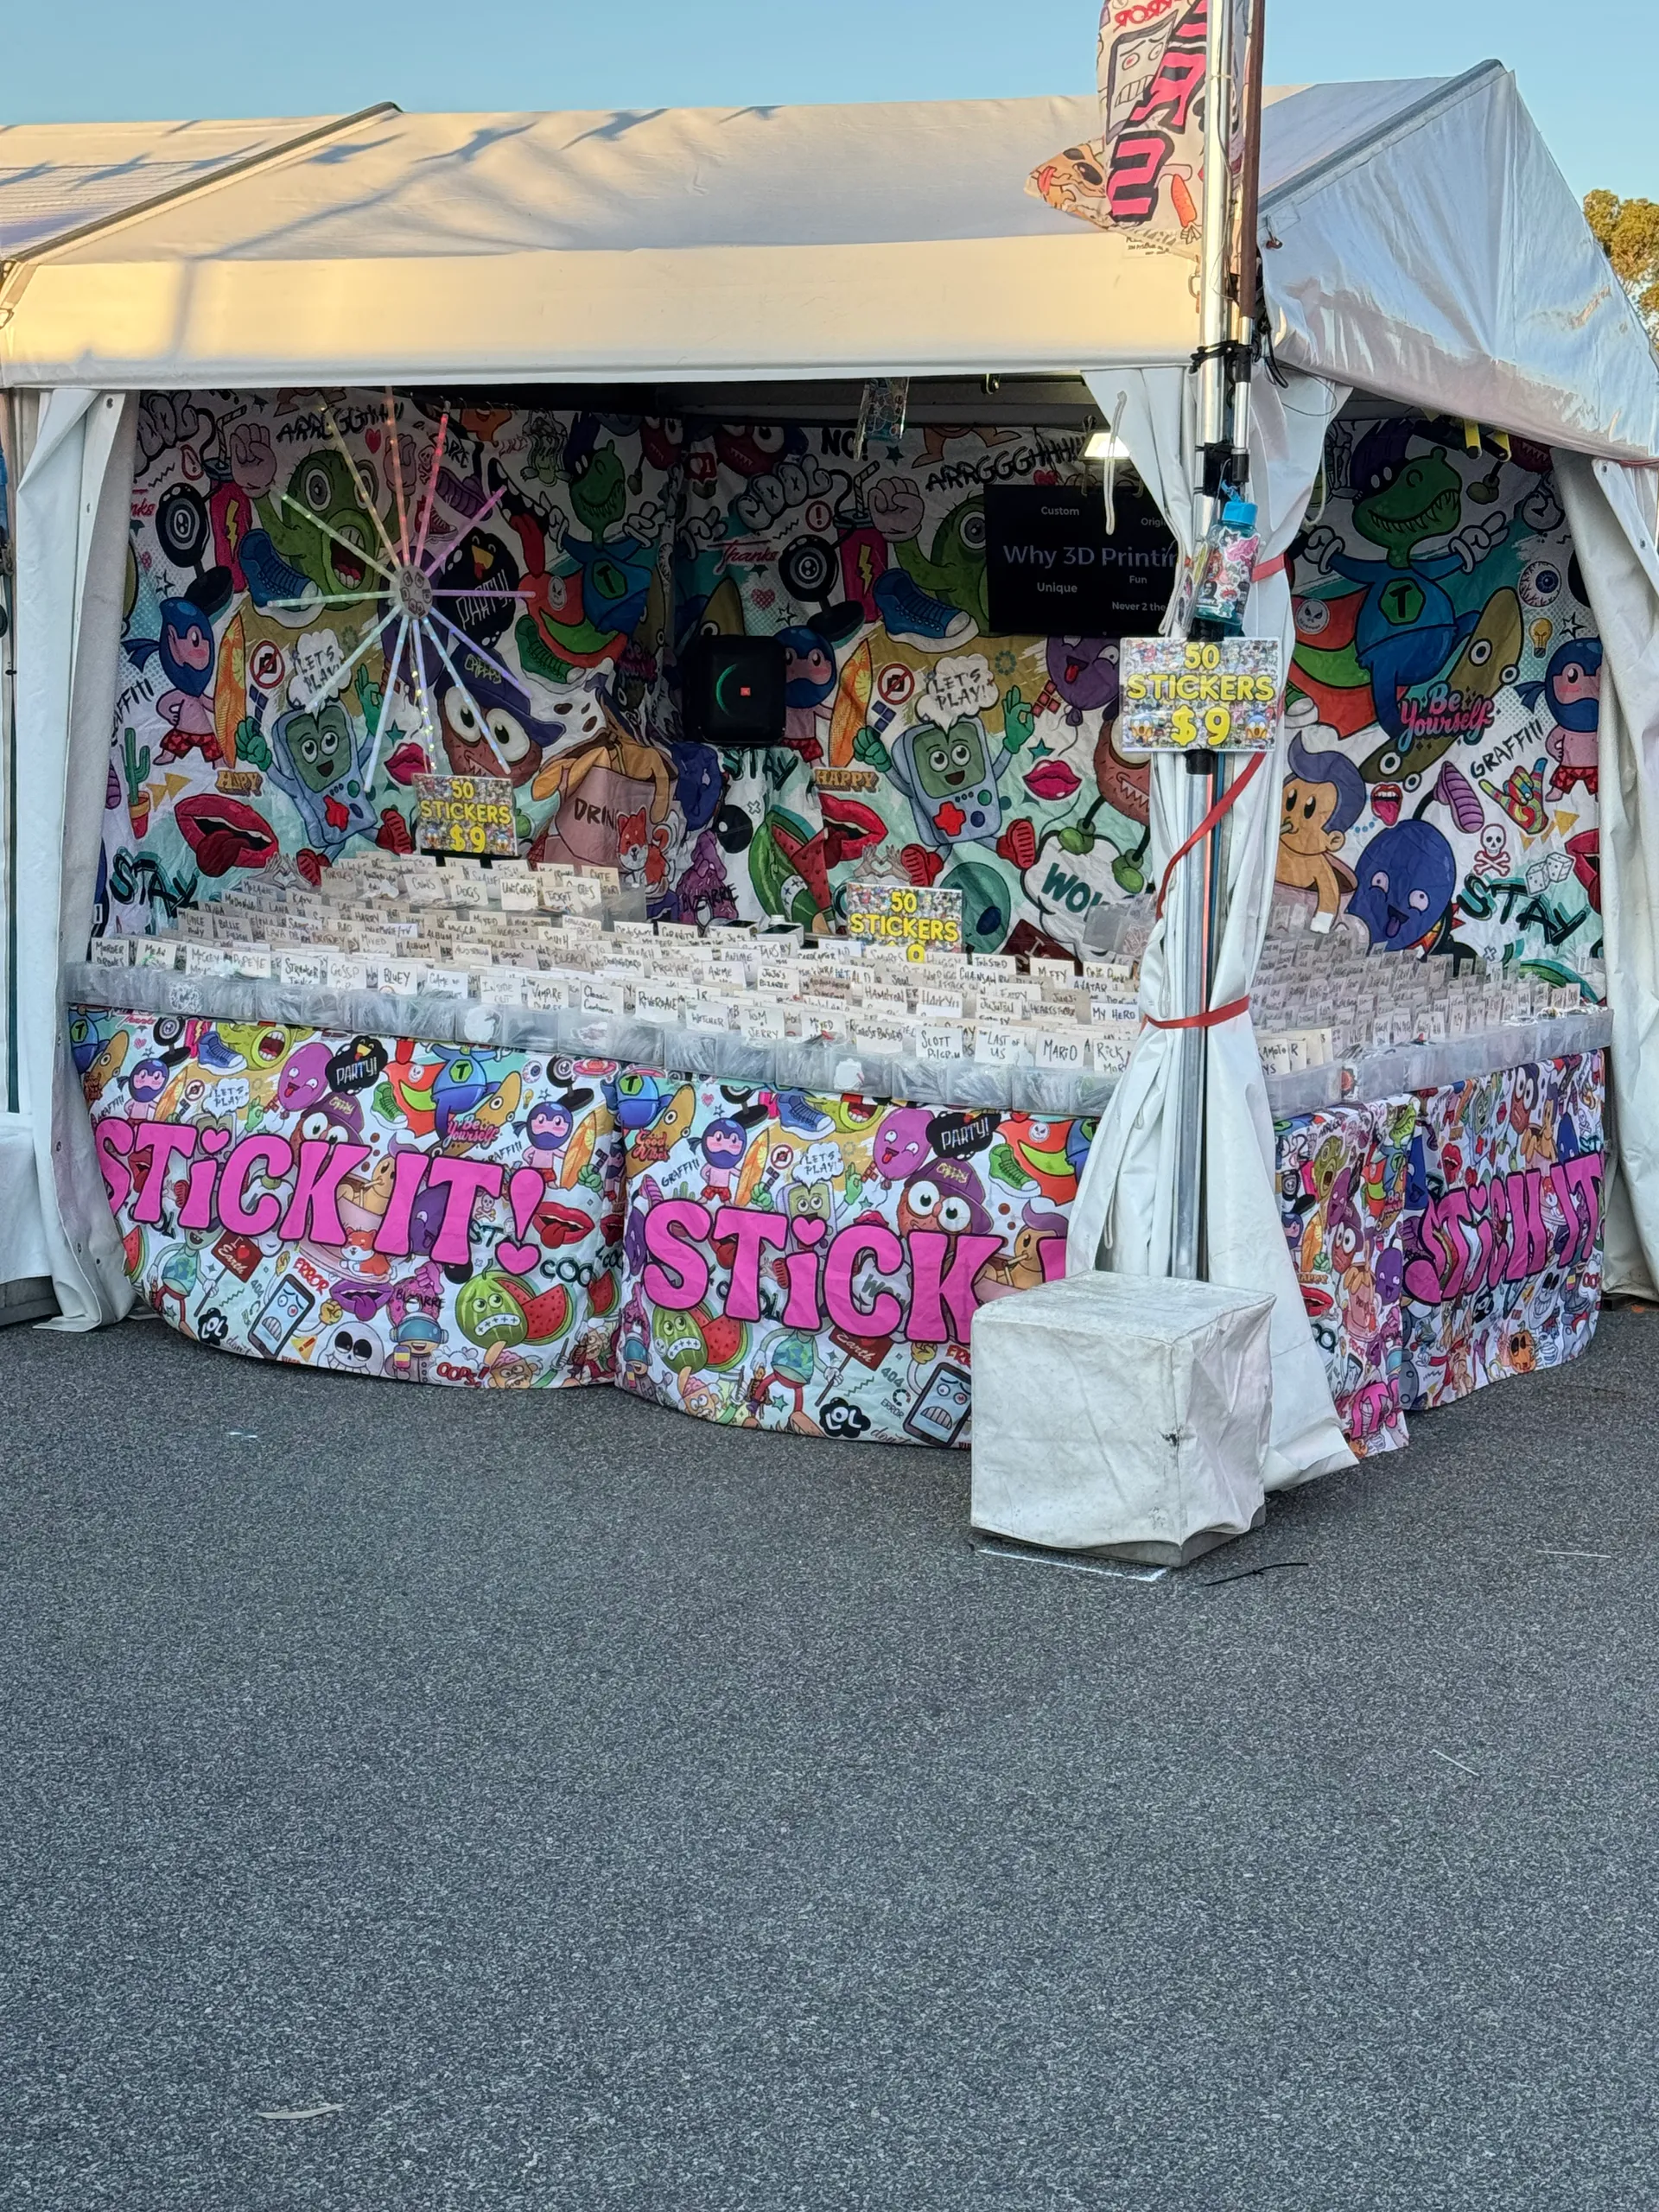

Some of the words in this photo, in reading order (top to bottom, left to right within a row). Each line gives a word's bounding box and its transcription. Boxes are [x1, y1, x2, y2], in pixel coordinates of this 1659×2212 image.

[1040, 505, 1080, 516] Custom
[1002, 544, 1057, 569] Why
[1063, 546, 1096, 566] 3D
[1036, 582, 1078, 594] Unique
[1128, 575, 1147, 584] Fun
[1111, 601, 1140, 612] Never
[1141, 601, 1148, 611] 2
[1388, 582, 1414, 620] T
[1183, 643, 1222, 671] 50
[931, 667, 982, 693] LET'S
[1126, 672, 1276, 702] STICKERS
[935, 683, 989, 712] PLAY!
[1427, 682, 1462, 715] Be
[1169, 704, 1232, 747] $9
[1398, 696, 1494, 753] Yourself
[451, 780, 475, 800] 50
[816, 768, 880, 792] HAPPY
[420, 799, 512, 824] STICKERS
[448, 823, 486, 854] $9
[891, 891, 918, 913] 50
[849, 913, 959, 942] STICKERS
[1092, 1006, 1107, 1020] MY
[1111, 1008, 1136, 1020] HERO
[335, 1058, 378, 1086] PARTY!
[447, 1121, 499, 1147] Yourself
[940, 1120, 990, 1151] PARTY!
[372, 1150, 546, 1275] IT!
[217, 1243, 249, 1275] Earth
[292, 1256, 330, 1297] ERROR
[200, 1315, 226, 1339] LOL
[836, 1332, 877, 1363] Earth
[880, 1366, 906, 1389] 404
[824, 1405, 862, 1431] LOL
[880, 1397, 905, 1420] ERROR
